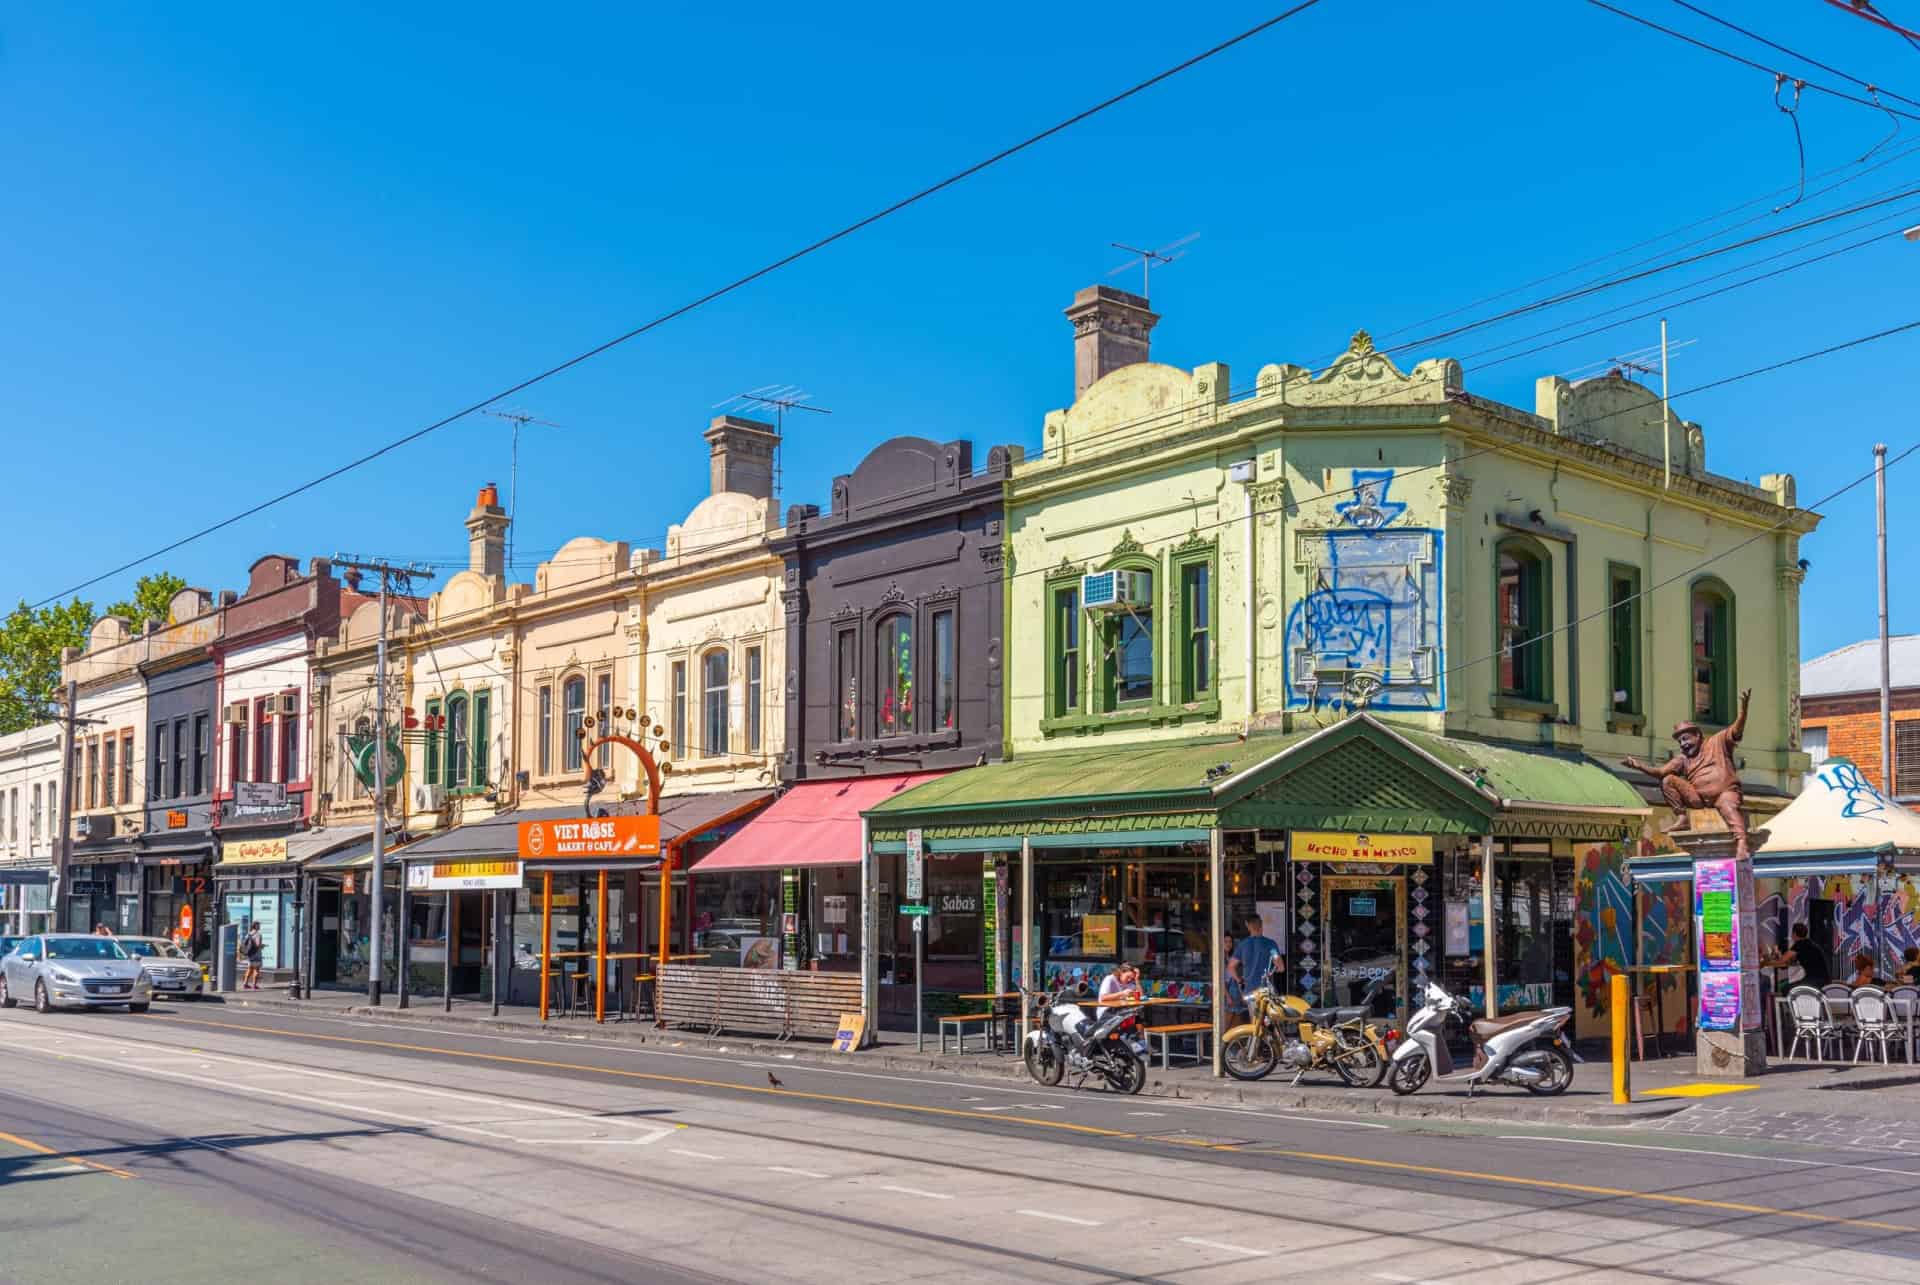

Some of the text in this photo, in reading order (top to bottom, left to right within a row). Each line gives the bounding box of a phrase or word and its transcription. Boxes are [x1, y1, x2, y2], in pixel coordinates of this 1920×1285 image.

[553, 824, 580, 839] VIET
[183, 877, 206, 895] T2
[942, 894, 976, 911] Saba's
